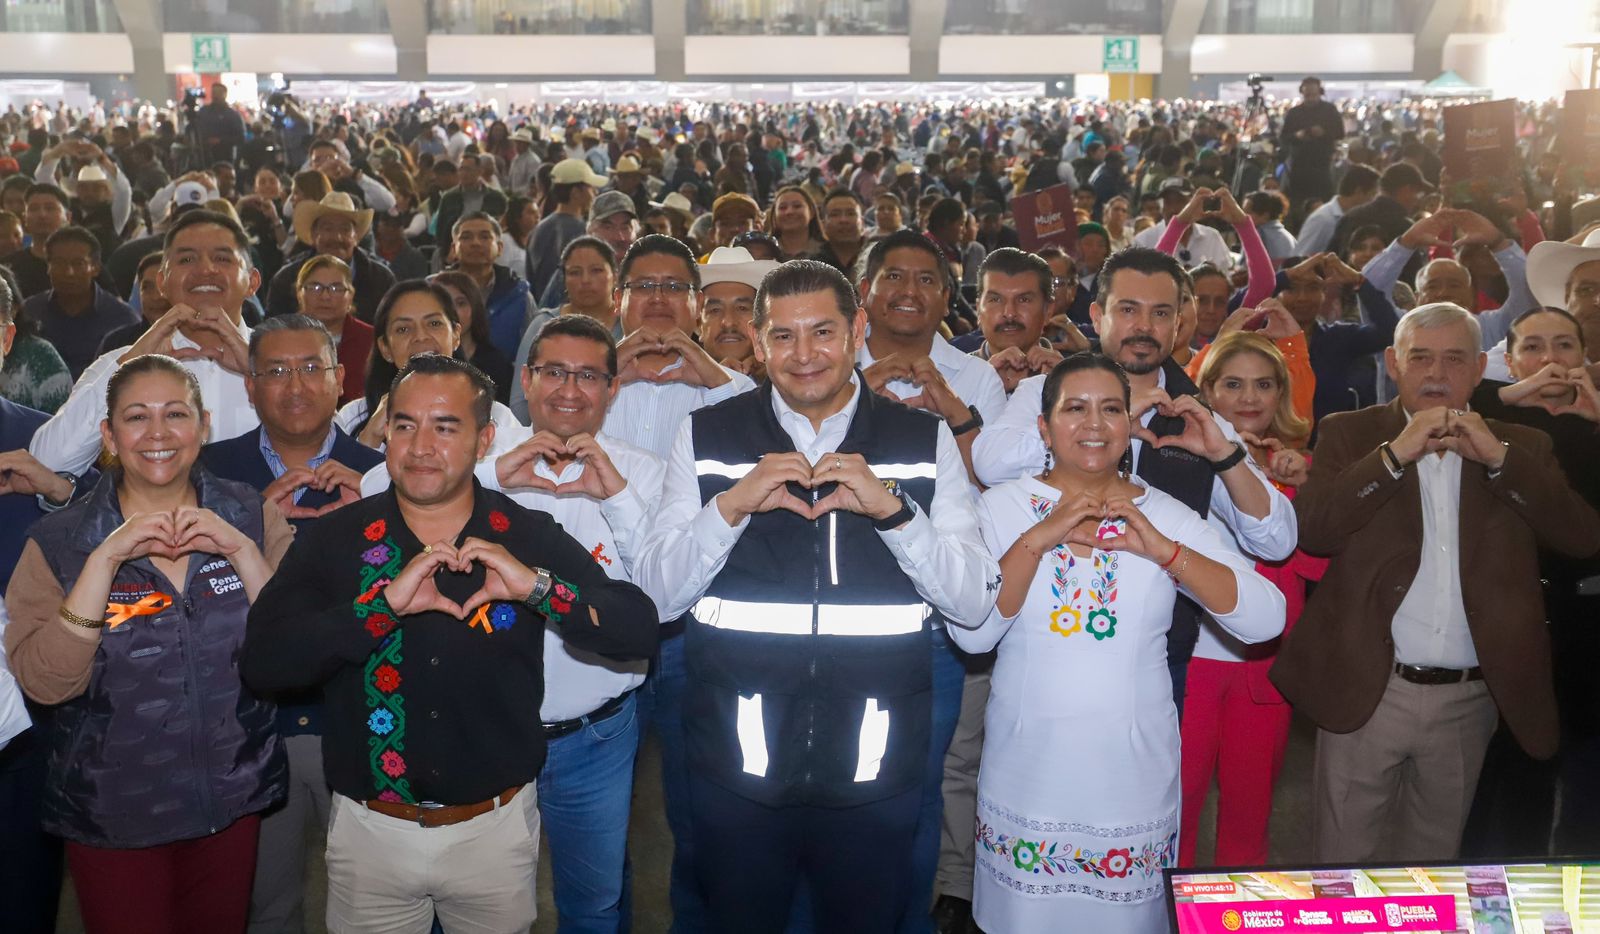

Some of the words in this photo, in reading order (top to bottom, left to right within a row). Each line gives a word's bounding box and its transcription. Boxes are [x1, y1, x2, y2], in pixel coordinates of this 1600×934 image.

[1034, 213, 1062, 225] Mujer
[209, 574, 239, 589] Pens
[214, 580, 244, 595] Gran
[1400, 905, 1436, 915] PUEBLA
[1244, 916, 1284, 929] México
